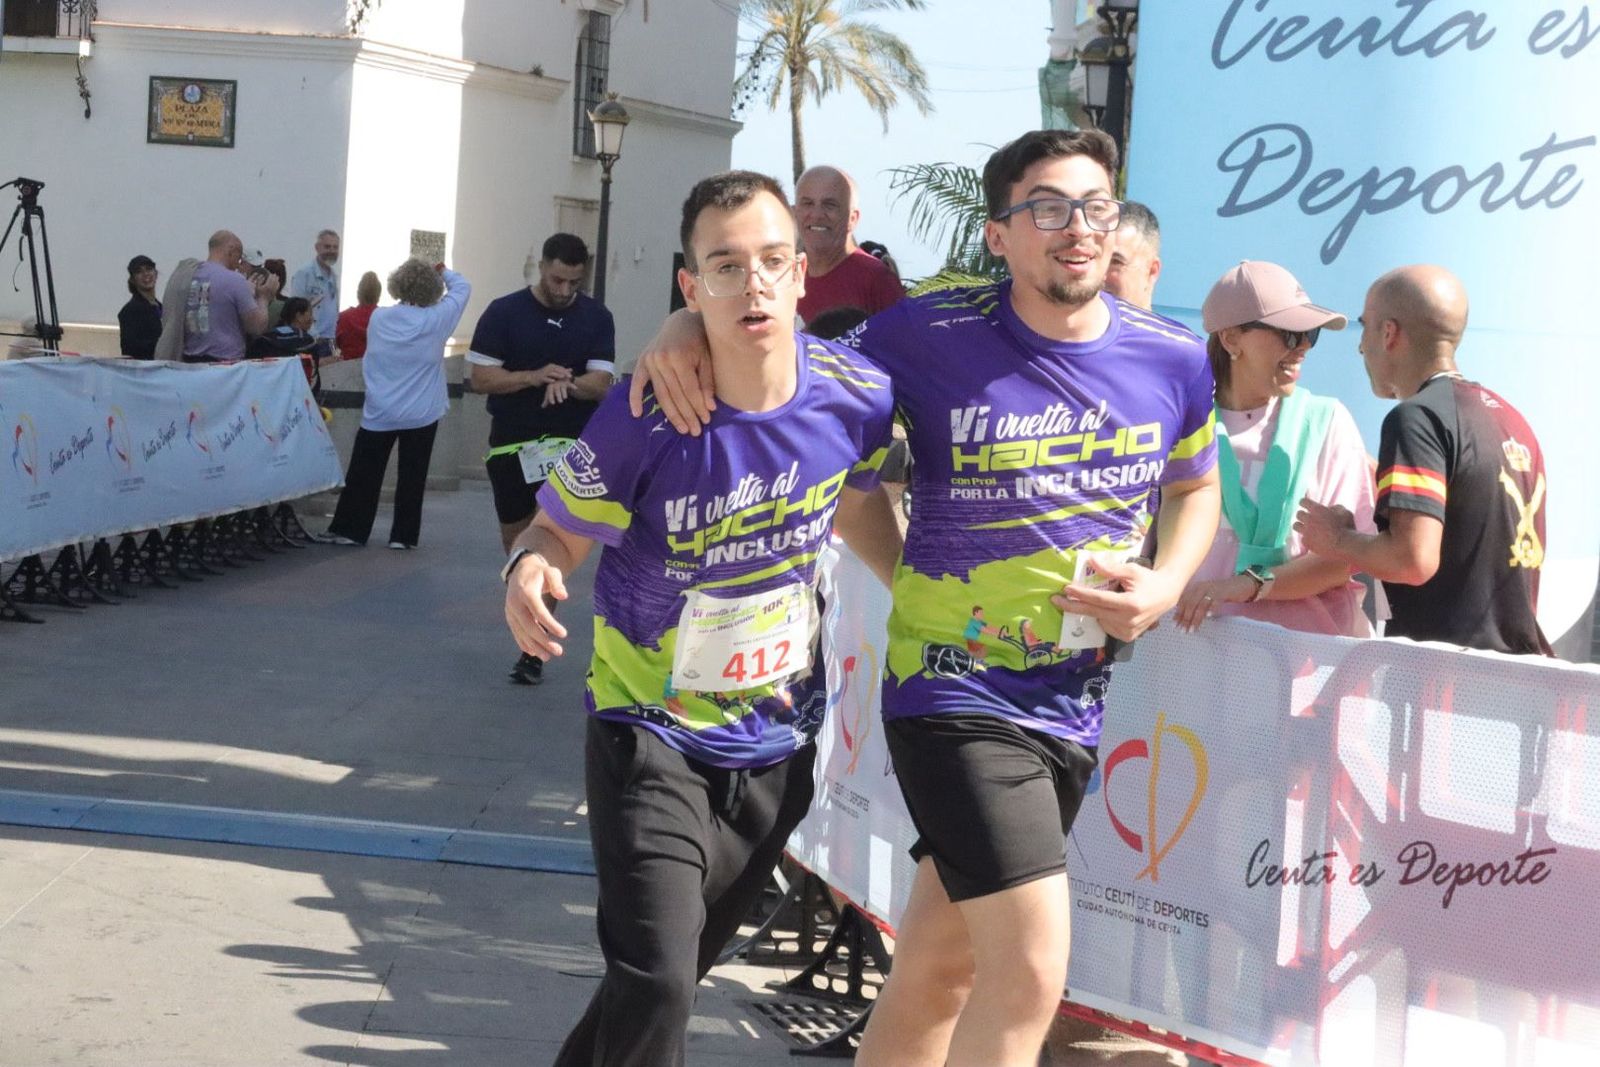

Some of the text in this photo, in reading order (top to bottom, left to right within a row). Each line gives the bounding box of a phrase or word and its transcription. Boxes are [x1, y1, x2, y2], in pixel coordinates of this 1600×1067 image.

[1211, 0, 1600, 70] Ceuta es
[175, 104, 209, 113] PLAZA
[1216, 122, 1597, 265] Deporte
[996, 402, 1077, 440] vuelta
[1079, 399, 1111, 432] al
[771, 460, 800, 498] al
[950, 457, 1165, 499] POR LA INCLUSIÓN
[763, 596, 784, 615] 10K
[722, 640, 791, 683] 412
[1245, 838, 1557, 909] Ceuta es Deporte
[1077, 899, 1103, 913] CIUDAD
[1153, 900, 1210, 928] DEPORTES
